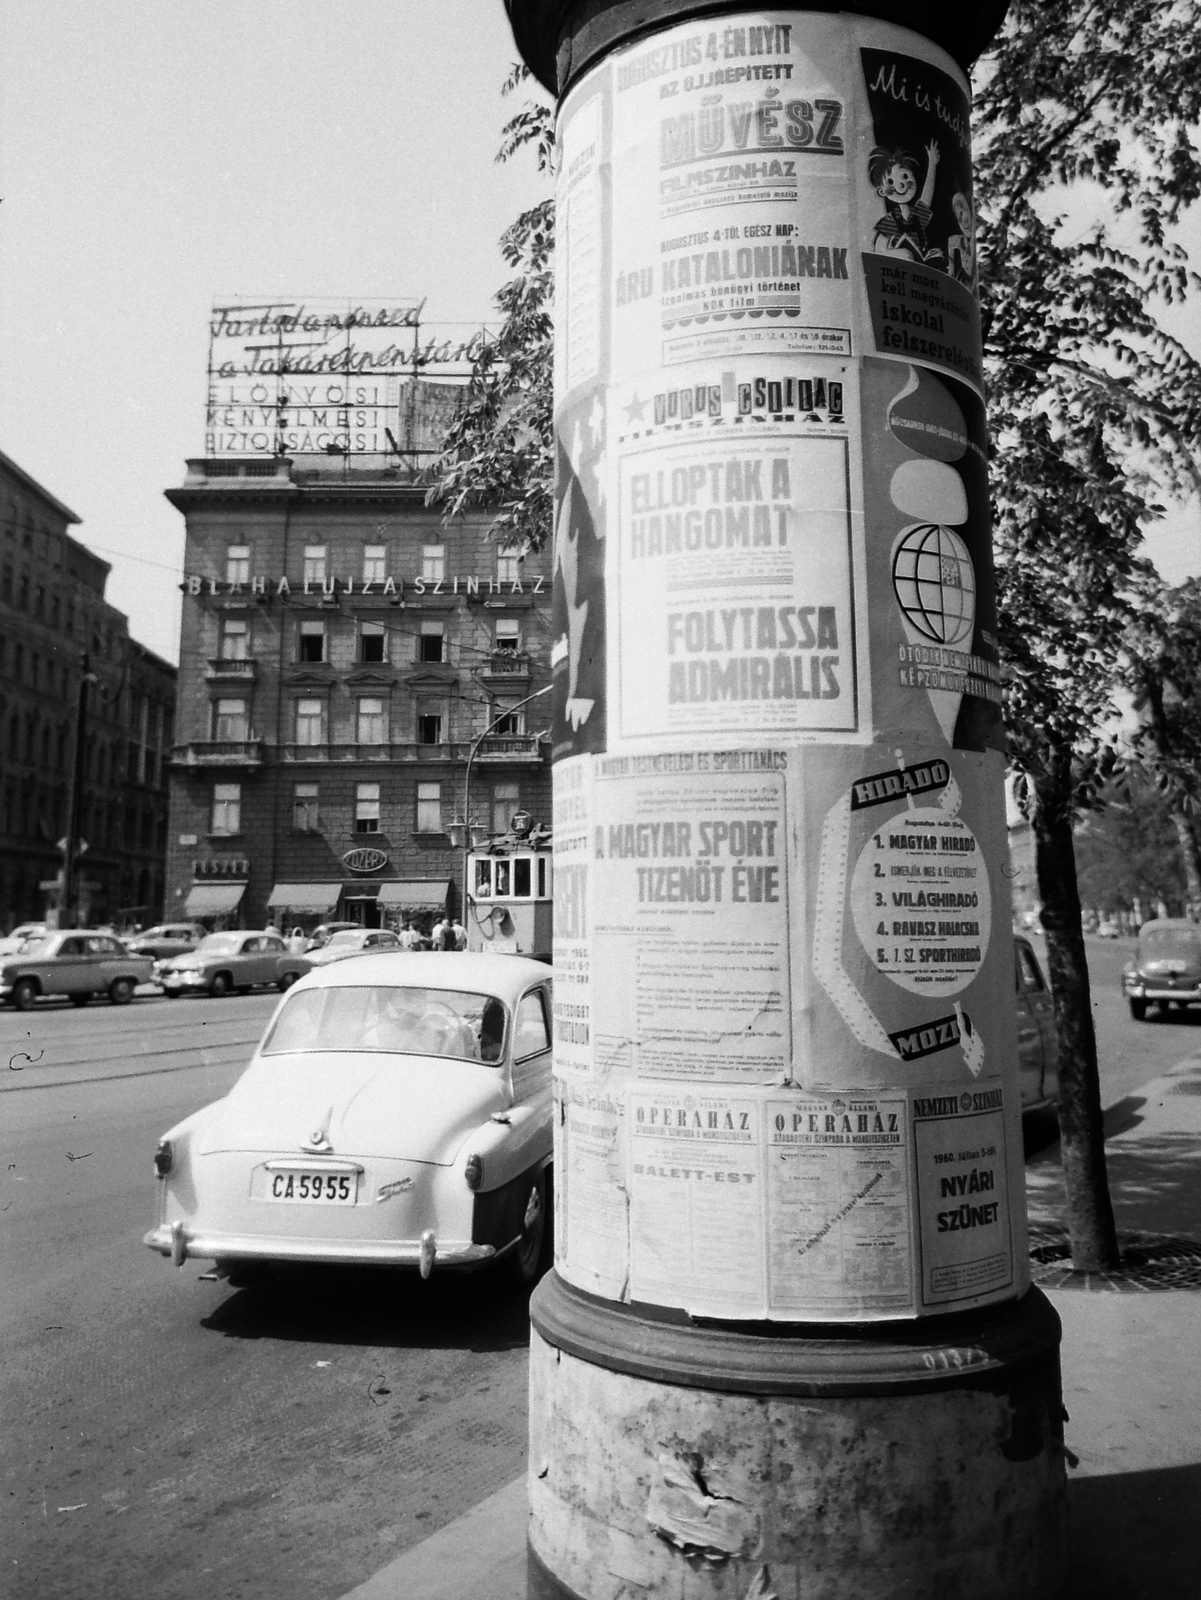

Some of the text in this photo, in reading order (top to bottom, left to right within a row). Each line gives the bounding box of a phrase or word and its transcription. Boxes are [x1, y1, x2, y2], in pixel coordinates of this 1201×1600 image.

[750, 24, 792, 56] NYIT
[660, 80, 679, 99] AZ
[870, 62, 910, 102] Mi
[915, 83, 931, 111] is
[659, 85, 844, 166] MŰVÉSZ
[743, 222, 772, 238] EGÉSZ
[775, 223, 799, 237] NAP:
[758, 281, 801, 292] történet
[881, 266, 939, 290] már most
[881, 279, 906, 297] kell
[730, 297, 755, 307] film
[882, 300, 945, 333] iskolai
[737, 376, 843, 416] CSILLAG
[771, 458, 791, 500] A
[631, 504, 792, 559] HANGOMAT
[188, 576, 291, 595] BLAHA
[304, 576, 396, 595] LUJZA
[666, 606, 839, 655] FOLYTASSA
[668, 652, 840, 704] ADMIRÁLIS
[855, 761, 948, 802] HIRADÓ
[609, 822, 692, 859] MAGYAR
[698, 820, 778, 857] SPORT
[873, 834, 976, 851] 1. MAGYAR HIRADÓ
[636, 859, 725, 902] TIZENÖT
[732, 859, 779, 902] ÉVE
[874, 863, 886, 877] 2.
[875, 890, 978, 908] 3. VILÁGHIRADÓ
[876, 921, 889, 936] 4.
[893, 921, 936, 936] RAVASZ
[877, 948, 889, 963] 5.
[919, 945, 981, 963] SPORTHIRADÓ
[898, 1021, 960, 1055] MOZI
[636, 1106, 750, 1130] OPERAHÁZ
[913, 1096, 958, 1117] NEMZETI
[775, 1111, 898, 1133] OPERAHÁZ
[933, 1153, 955, 1164] 1960.
[633, 1163, 756, 1183] BALETT-EST
[941, 1168, 995, 1198] NYÁRI
[937, 1202, 999, 1233] SZÜNET
